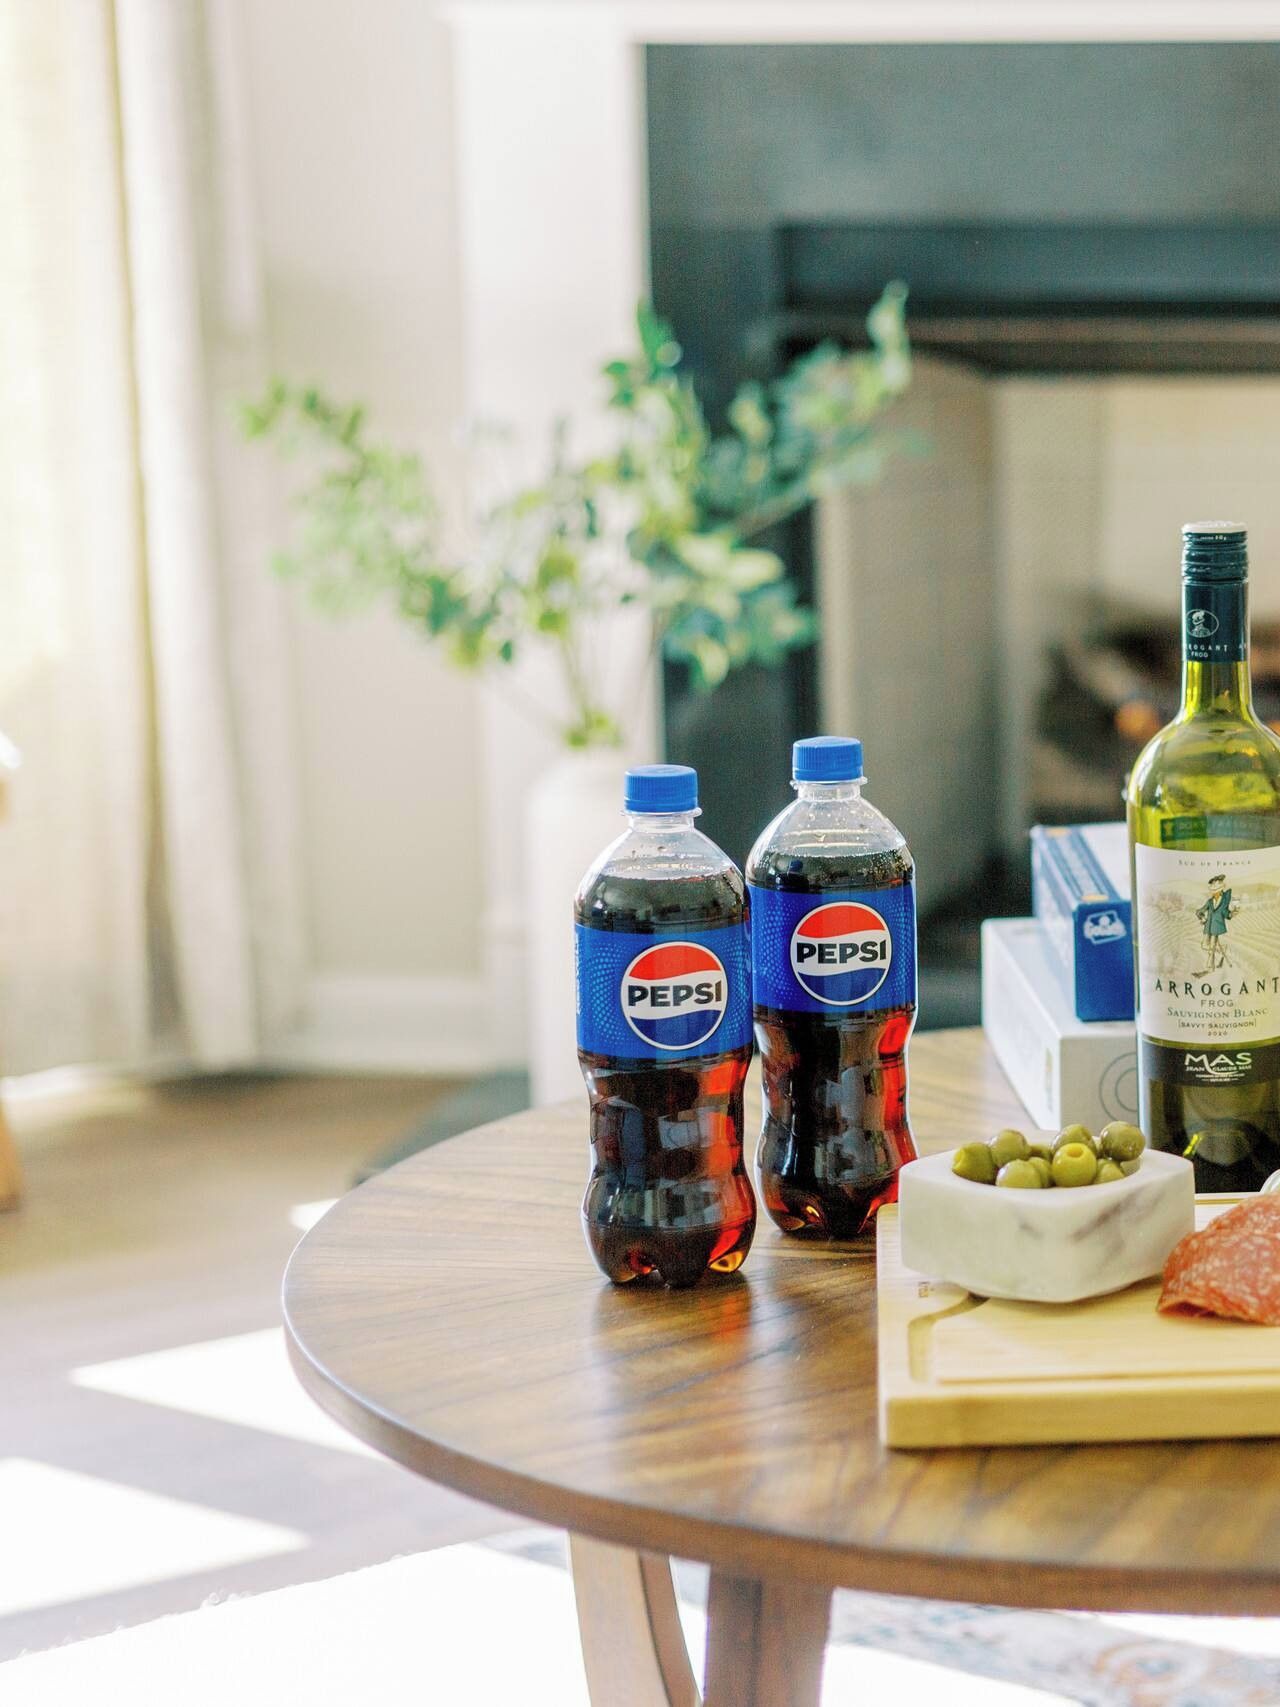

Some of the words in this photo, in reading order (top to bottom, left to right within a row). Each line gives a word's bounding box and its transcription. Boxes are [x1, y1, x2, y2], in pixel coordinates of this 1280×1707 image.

[796, 940, 887, 965] PEPSI
[627, 980, 722, 1008] PEPSI
[1155, 976, 1279, 999] ARROGANT
[1167, 1006, 1229, 1019] SAUVIGNON
[1234, 1008, 1268, 1018] BLANC
[1200, 1000, 1234, 1008] FROG
[1184, 1052, 1252, 1075] MAS
